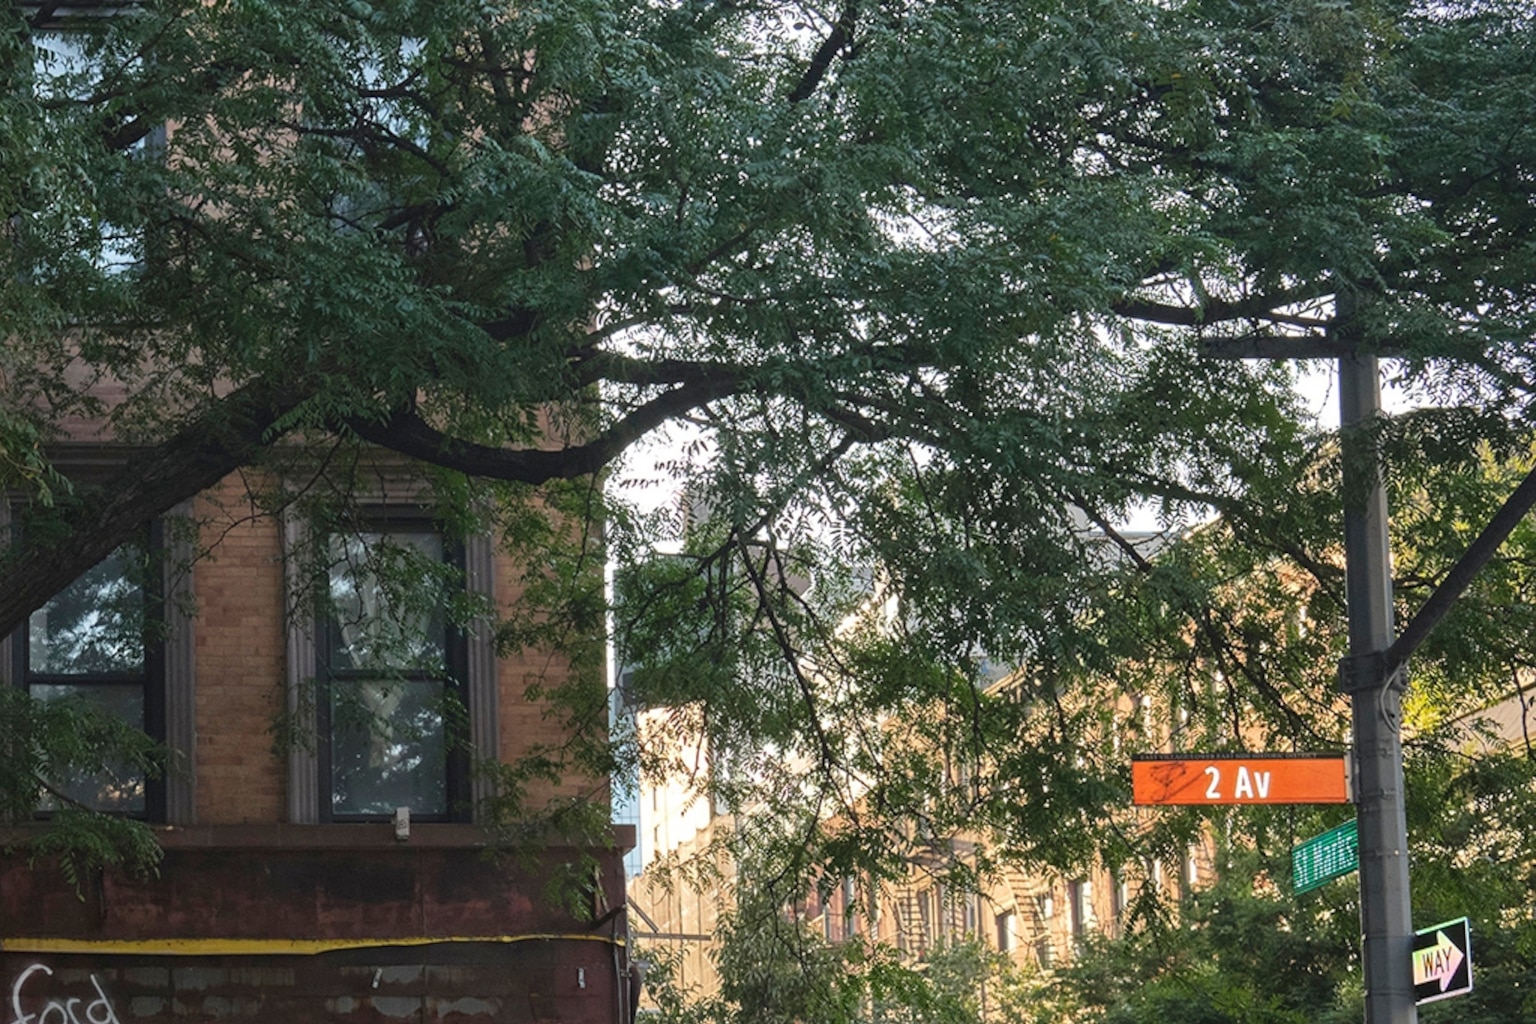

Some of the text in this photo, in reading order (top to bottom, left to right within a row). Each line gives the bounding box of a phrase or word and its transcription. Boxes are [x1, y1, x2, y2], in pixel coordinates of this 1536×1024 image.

[1205, 766, 1271, 799] 2 Av
[1295, 832, 1356, 888] St Marks
[1423, 946, 1452, 978] WAY
